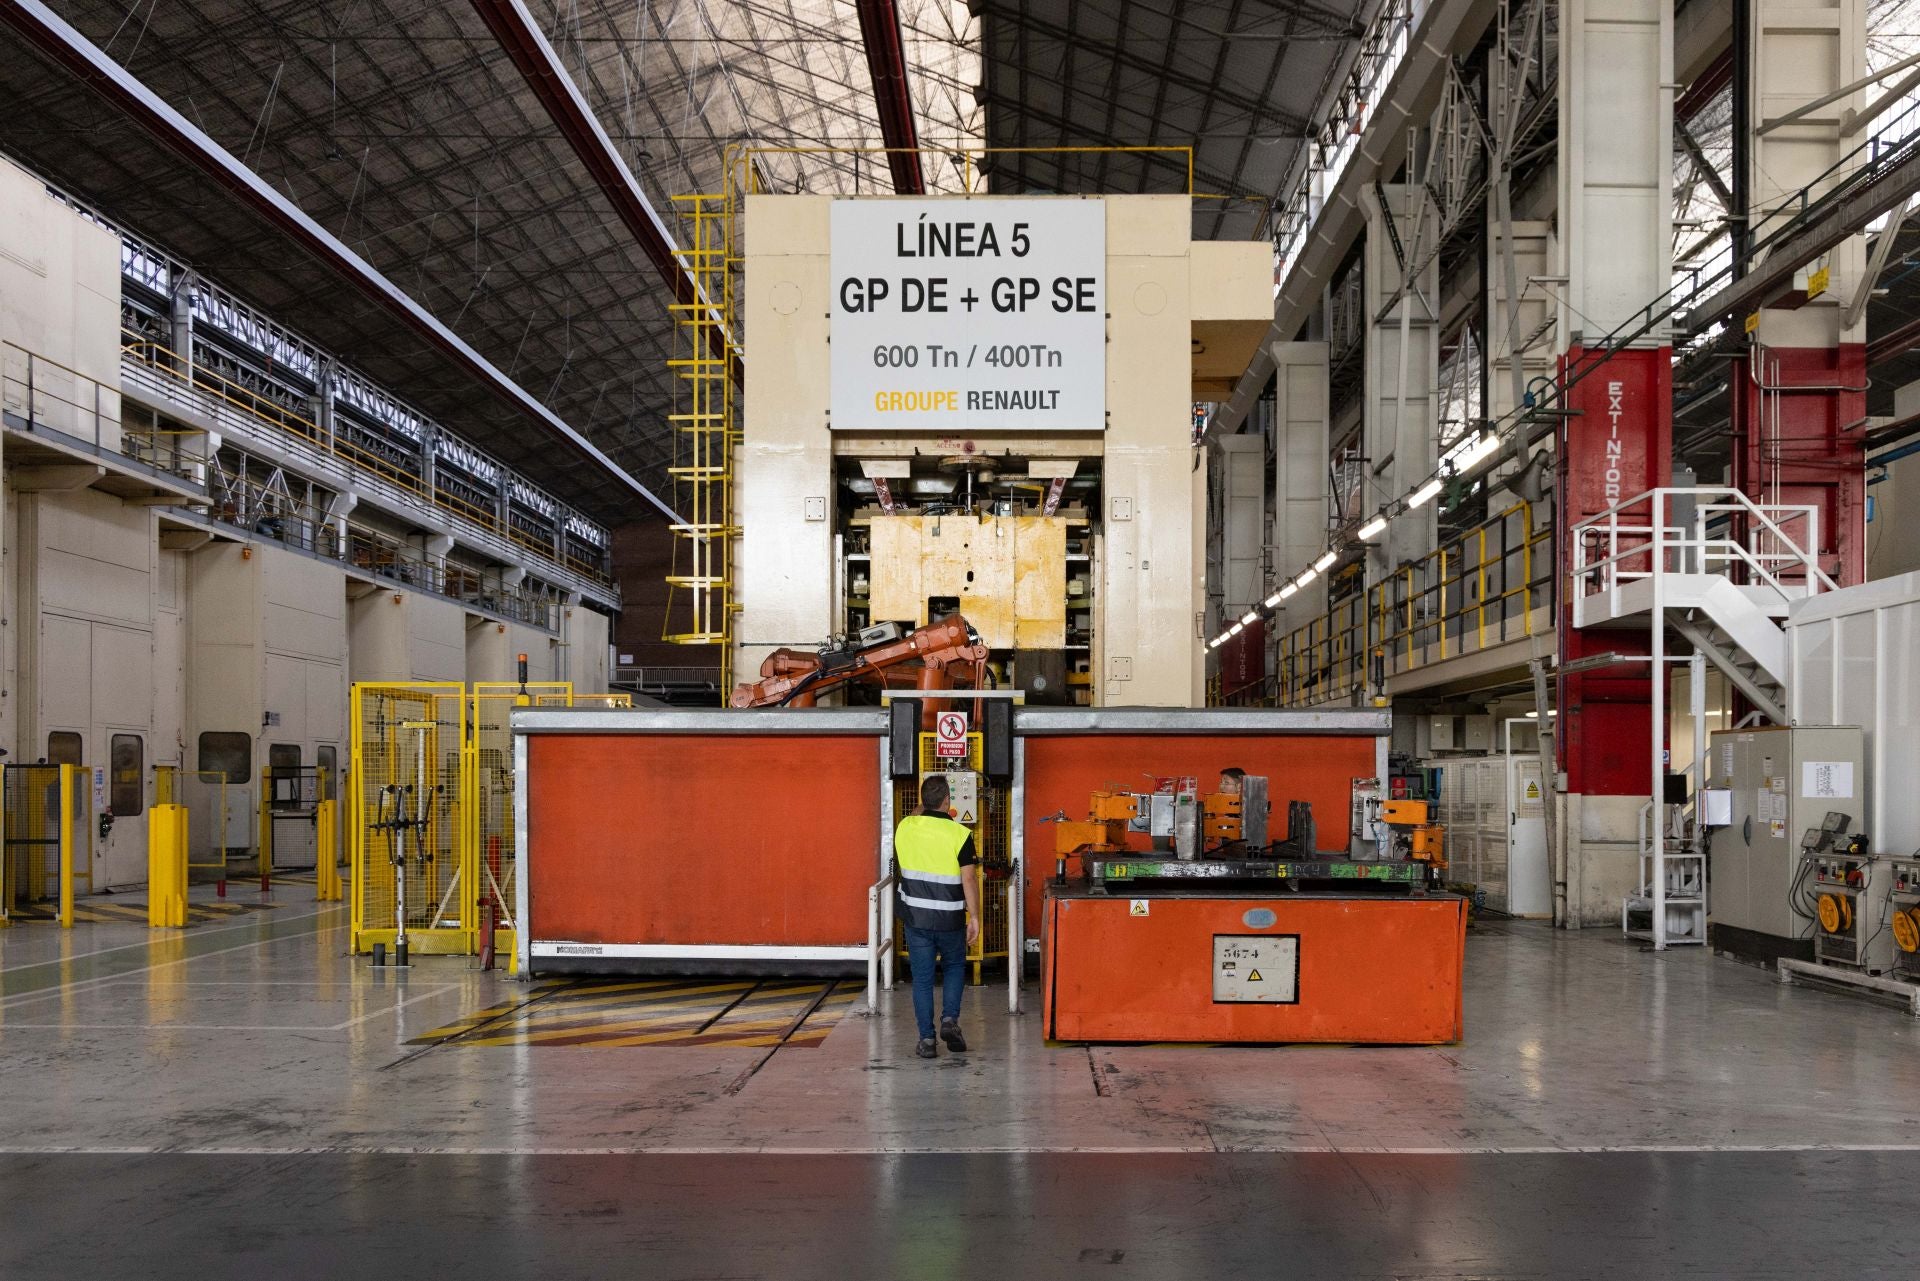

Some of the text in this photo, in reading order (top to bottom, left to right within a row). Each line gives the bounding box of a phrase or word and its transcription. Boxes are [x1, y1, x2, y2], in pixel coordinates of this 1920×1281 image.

[897, 213, 1030, 258] LÍNEA 5
[840, 277, 1096, 313] GP DE + GP SE
[873, 345, 1062, 368] 600 Tn / 400Tn
[875, 390, 1060, 411] GROUPE RENAULT
[1606, 382, 1623, 497] EXTINTOR
[1278, 864, 1287, 878] 5
